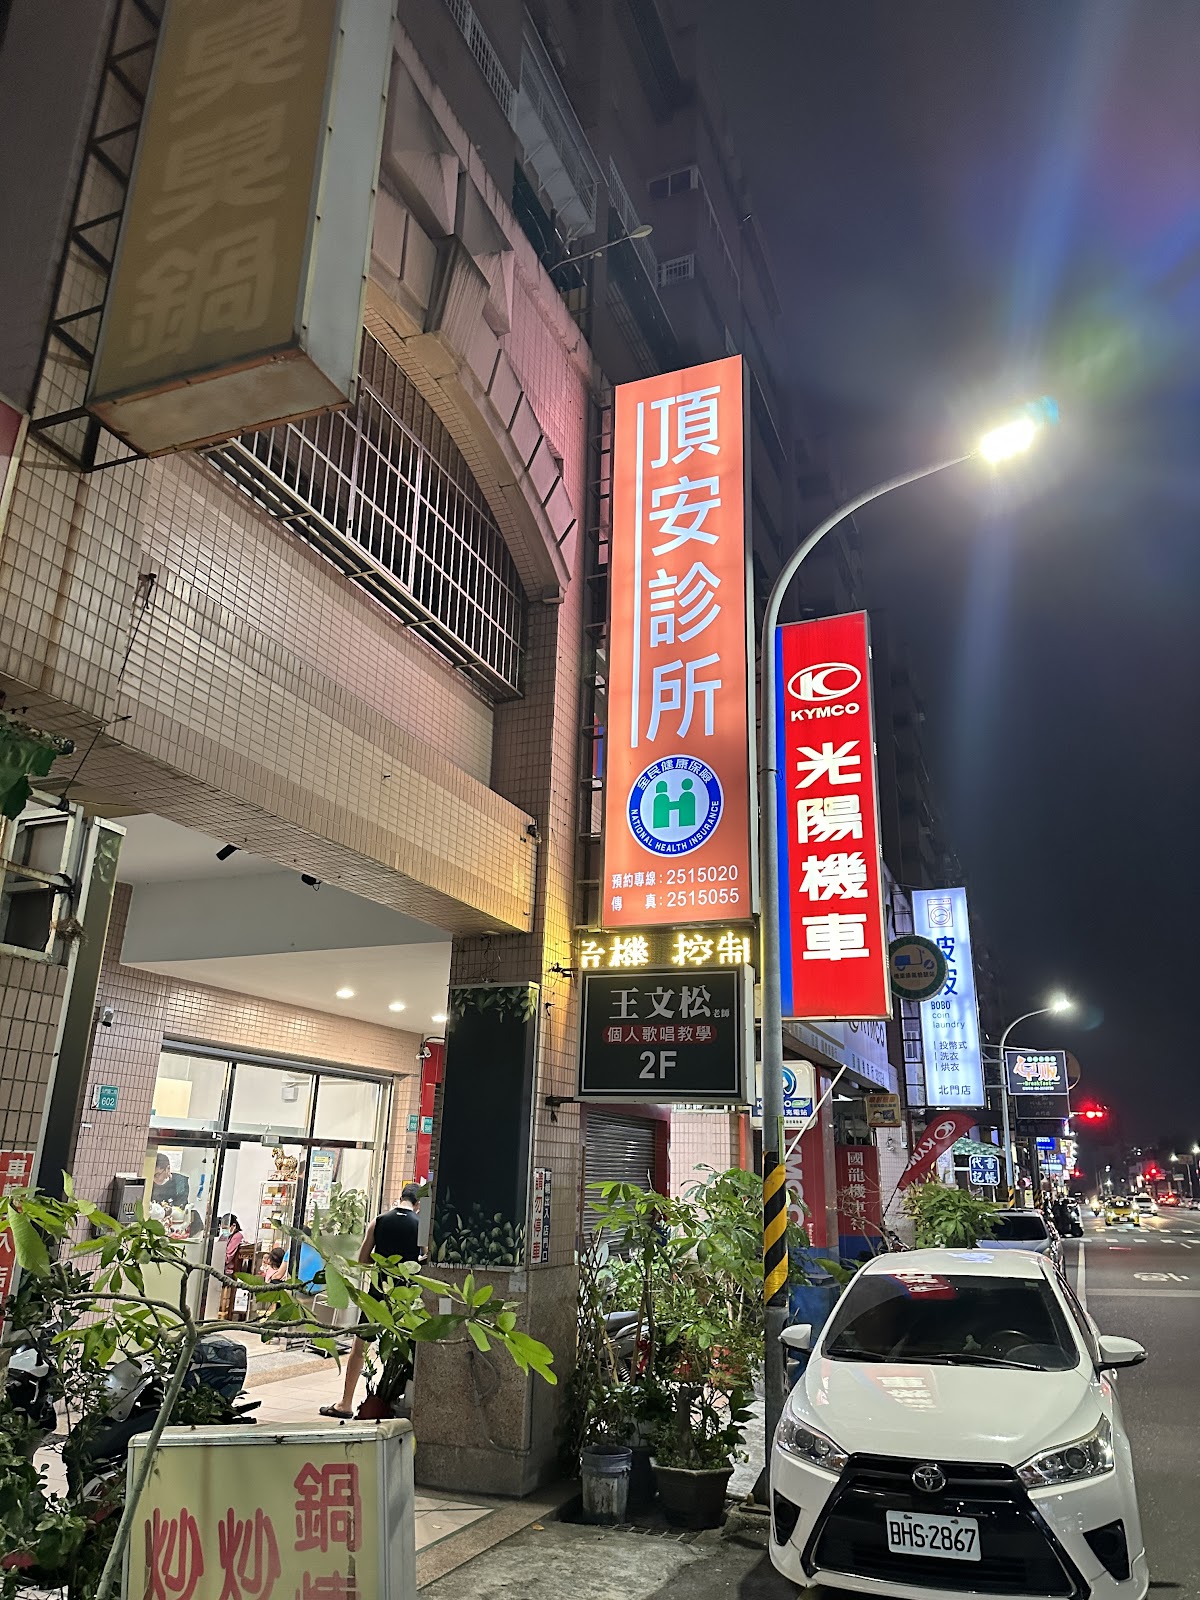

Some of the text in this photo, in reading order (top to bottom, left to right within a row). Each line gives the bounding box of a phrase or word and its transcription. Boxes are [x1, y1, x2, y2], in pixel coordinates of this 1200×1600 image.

[646, 385, 723, 743] 頂安診所
[790, 702, 860, 722] KYMCO
[636, 758, 713, 791] 全民健康保險
[631, 800, 720, 853] NATIONAL HEALTH INSURANCE
[794, 739, 870, 961] 光陽機車
[666, 865, 739, 885] 2515020
[667, 888, 740, 907] 2515055
[608, 984, 712, 1020] 王文松
[607, 1025, 712, 1043] 個人歌唱教學
[932, 1020, 966, 1030] laundry
[938, 1040, 968, 1050] 投幣式
[639, 1051, 678, 1079] 2F
[940, 1051, 960, 1061] 洗衣
[940, 1062, 960, 1072] 烘衣
[938, 1084, 971, 1096] 北門店
[101, 1097, 115, 1107] 602
[972, 1156, 996, 1169] 代書
[972, 1170, 997, 1184] 記帳
[532, 1171, 543, 1260] 請勿停車
[143, 1507, 204, 1600] 炒
[217, 1507, 281, 1600] 炒
